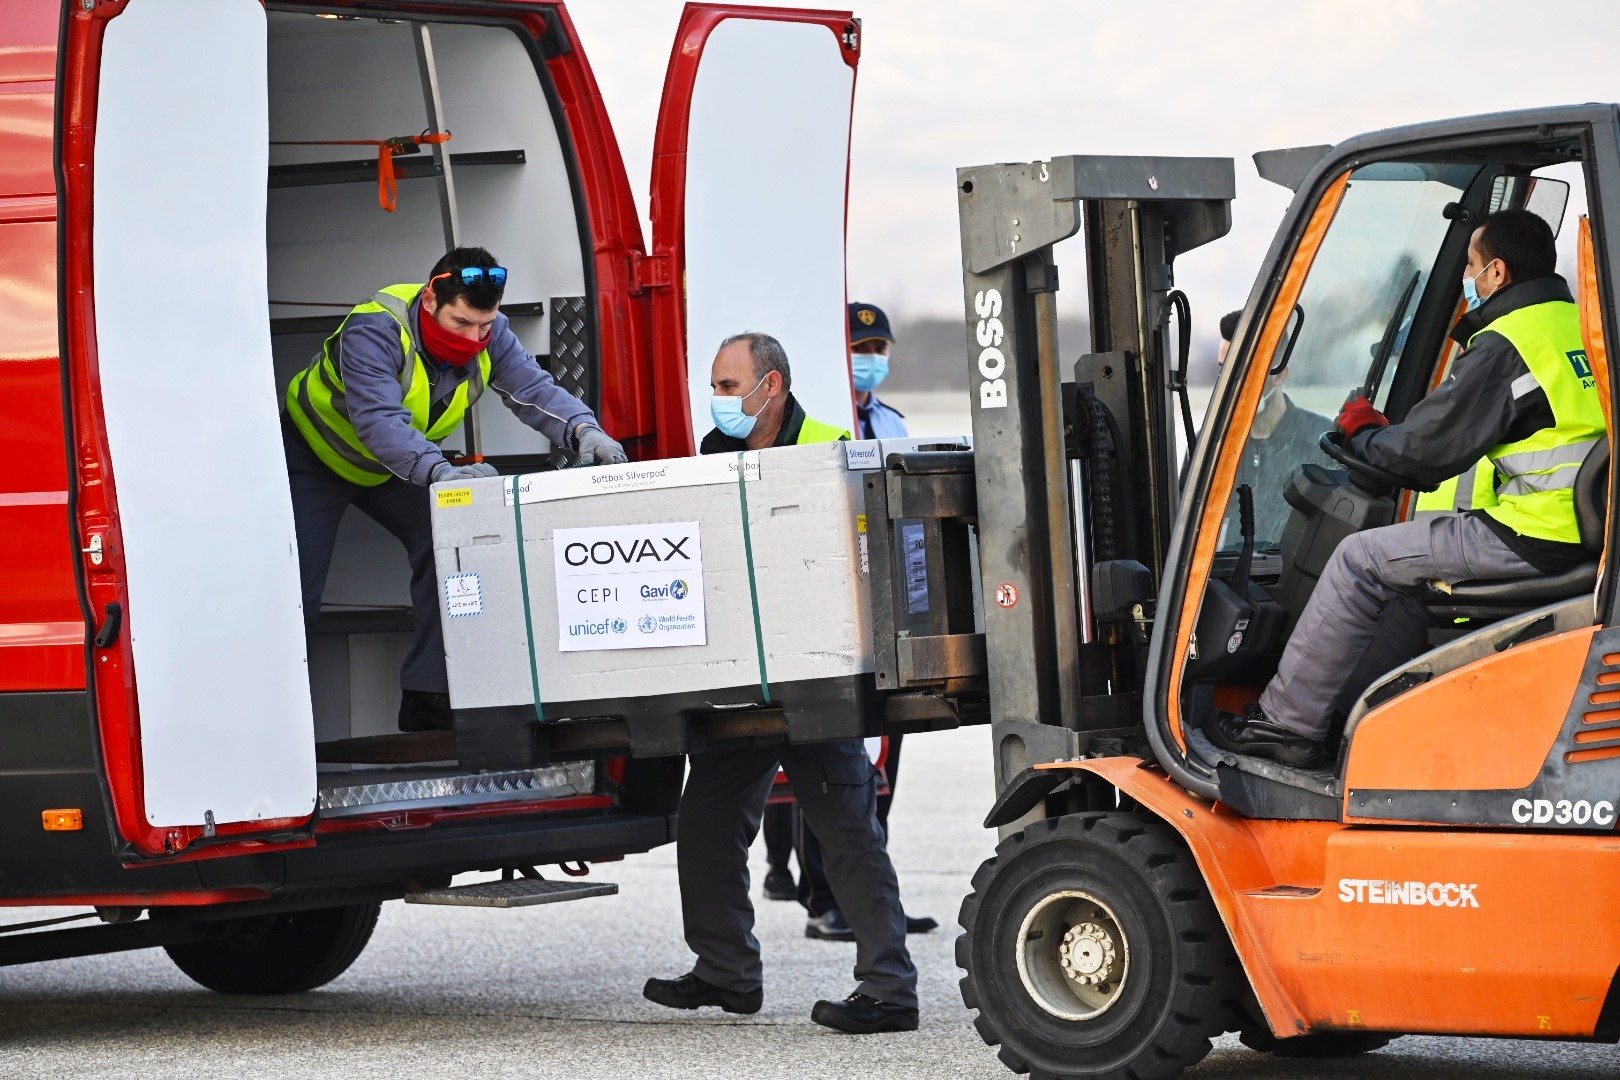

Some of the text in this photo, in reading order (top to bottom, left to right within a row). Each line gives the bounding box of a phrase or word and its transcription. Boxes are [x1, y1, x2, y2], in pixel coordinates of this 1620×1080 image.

[975, 289, 1007, 408] BOSS
[1572, 354, 1591, 373] T
[1583, 379, 1595, 389] Air
[728, 461, 760, 472] Sobox
[591, 468, 666, 484] Softbox Silverpod
[504, 484, 530, 495] erod
[564, 536, 691, 567] COVAX
[577, 587, 618, 604] CEPI
[640, 583, 669, 599] Gavi
[658, 614, 695, 623] World Health
[569, 619, 610, 636] unicef
[658, 623, 696, 632] Organization
[1512, 798, 1614, 826] CD30C
[1338, 879, 1480, 908] STEINBOCK
